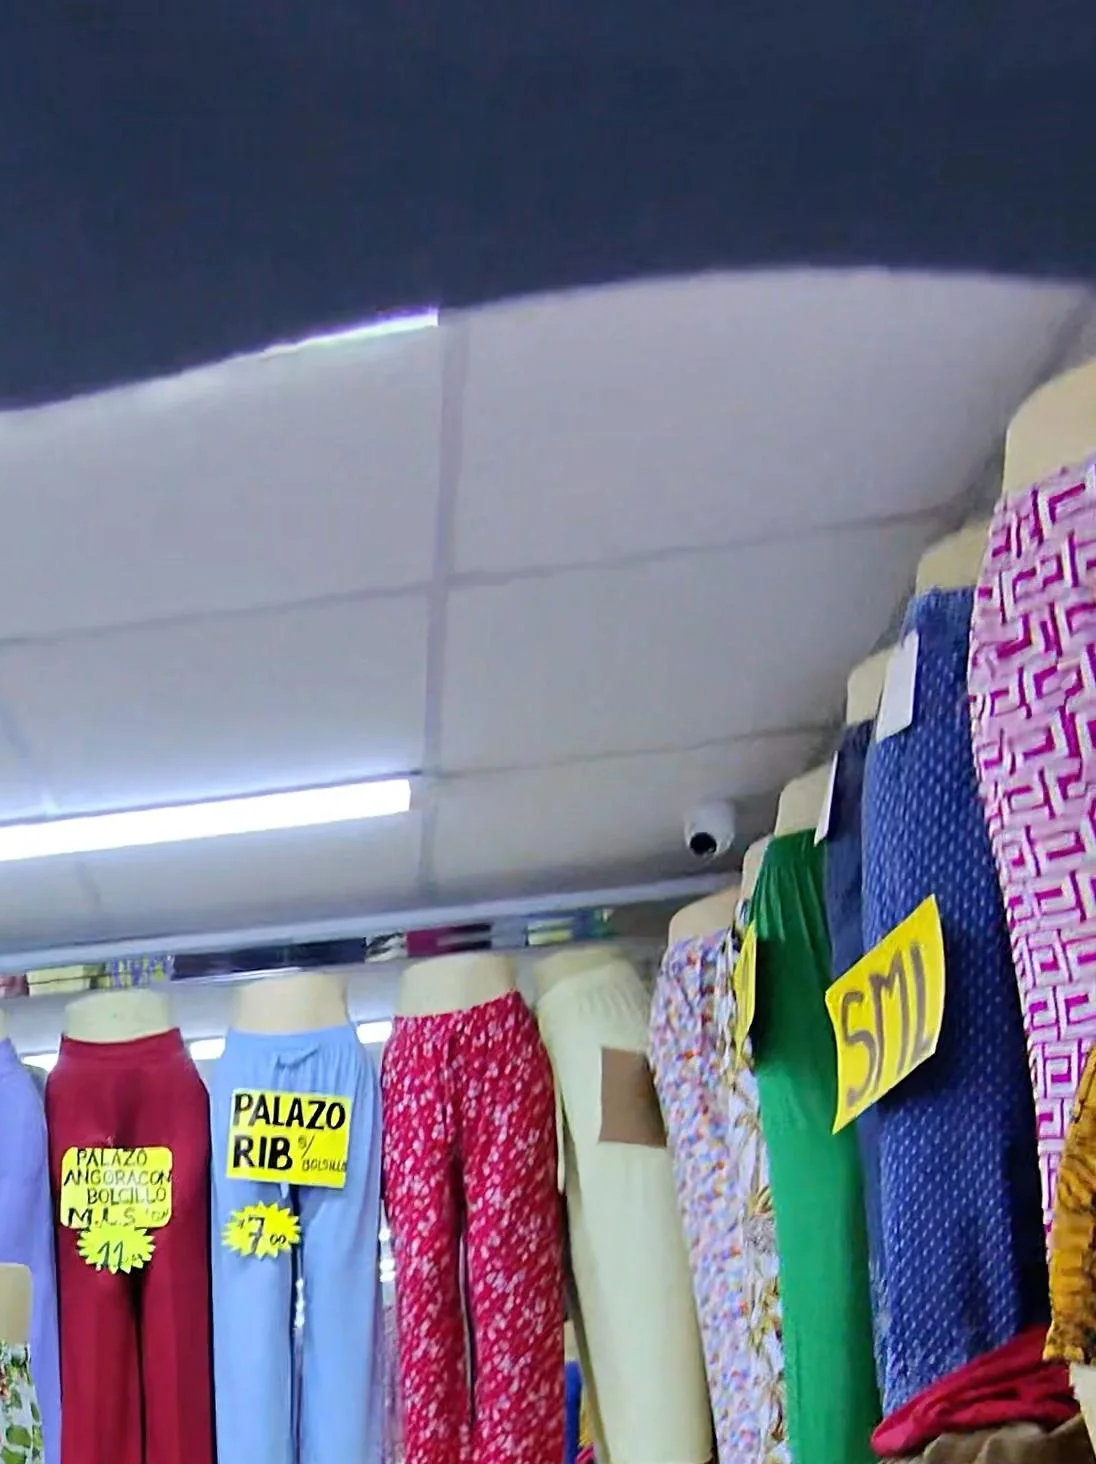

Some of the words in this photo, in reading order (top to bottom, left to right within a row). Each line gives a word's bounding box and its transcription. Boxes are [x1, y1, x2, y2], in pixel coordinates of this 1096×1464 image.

[841, 943, 933, 1107] SML
[233, 1093, 345, 1130] PALAZO
[77, 1148, 147, 1167] PALAZO
[233, 1135, 293, 1171] RIB
